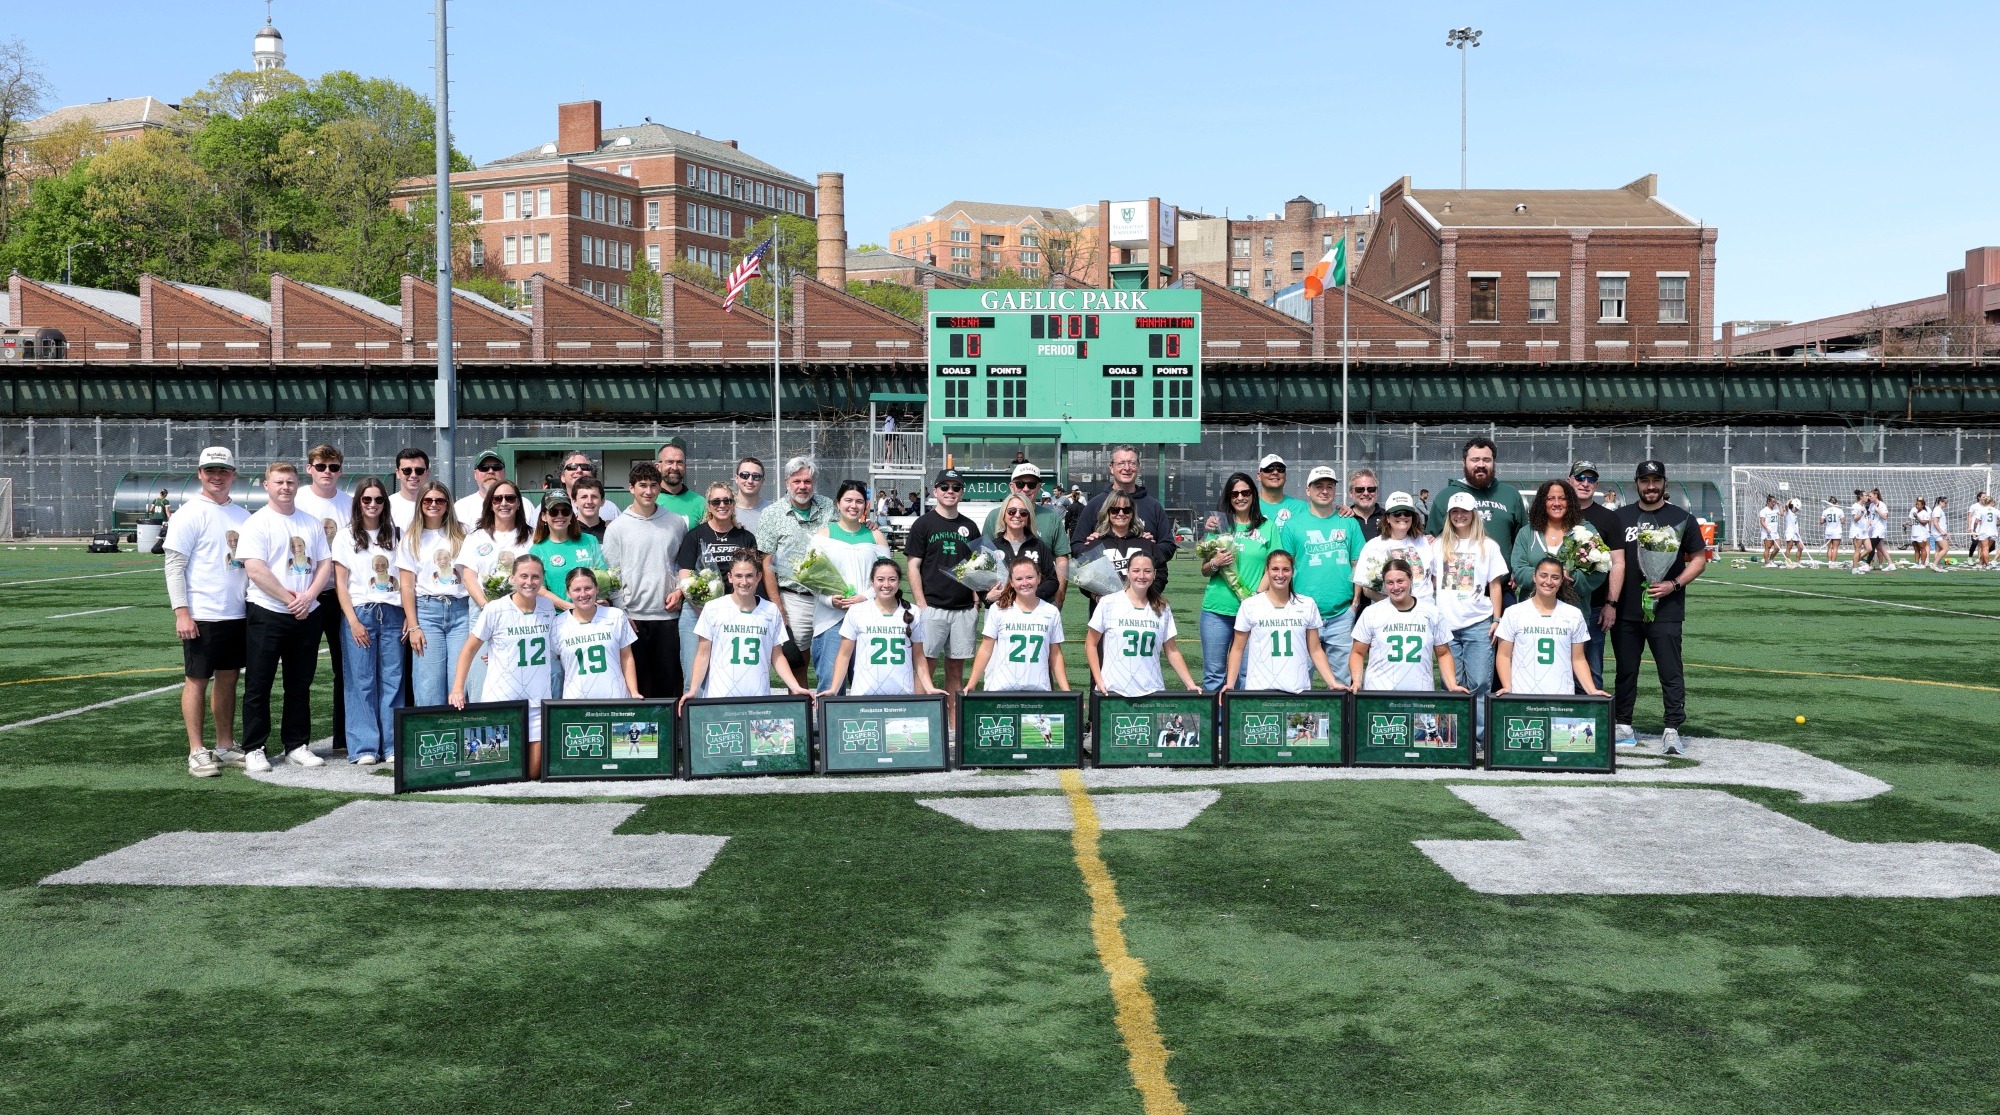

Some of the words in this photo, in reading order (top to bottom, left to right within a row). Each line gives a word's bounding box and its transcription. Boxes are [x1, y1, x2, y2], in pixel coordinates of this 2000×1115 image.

[981, 290, 1075, 310] GAELIC
[1081, 290, 1148, 310] PARK
[950, 317, 980, 328] SIENA
[1135, 317, 1194, 328] MANHATTAN
[967, 334, 980, 356] 0
[1038, 344, 1075, 356] PERIOD
[1166, 334, 1180, 357] 0
[942, 367, 971, 375] GOALS
[991, 367, 1022, 375] POINTS
[1108, 367, 1137, 375] GOALS
[1157, 367, 1188, 375] POINTS
[1826, 514, 1837, 523] 31
[1309, 542, 1347, 553] JASPERS
[1005, 623, 1049, 633] MANHATTAN
[1118, 618, 1160, 629] MANHATTAN
[1258, 618, 1303, 628] MANHATTAN
[1382, 623, 1426, 633] MANHATTAN
[507, 624, 550, 636] MANHATTAN
[723, 624, 768, 636] MANHATTAN
[866, 626, 906, 635] MANHATTA
[1523, 626, 1568, 636] MANHATTAN
[565, 632, 612, 647] MANHATTAN
[1123, 629, 1156, 657] 30
[1270, 629, 1294, 657] 11
[517, 636, 546, 667] 12
[730, 636, 761, 665] 13
[870, 637, 906, 665] 25
[1009, 634, 1044, 663] 27
[1386, 635, 1423, 663] 32
[1537, 637, 1555, 665] 9
[575, 644, 607, 675] 19
[982, 727, 1012, 735] JASPERS
[1118, 727, 1148, 735] JASPERS
[1248, 725, 1277, 733] JASPERS
[1511, 729, 1542, 738] JASPERS
[569, 736, 601, 746] JASPERS
[710, 733, 740, 743] JASPERS
[846, 731, 877, 740] JASPERS
[423, 744, 455, 755] JASPERS
